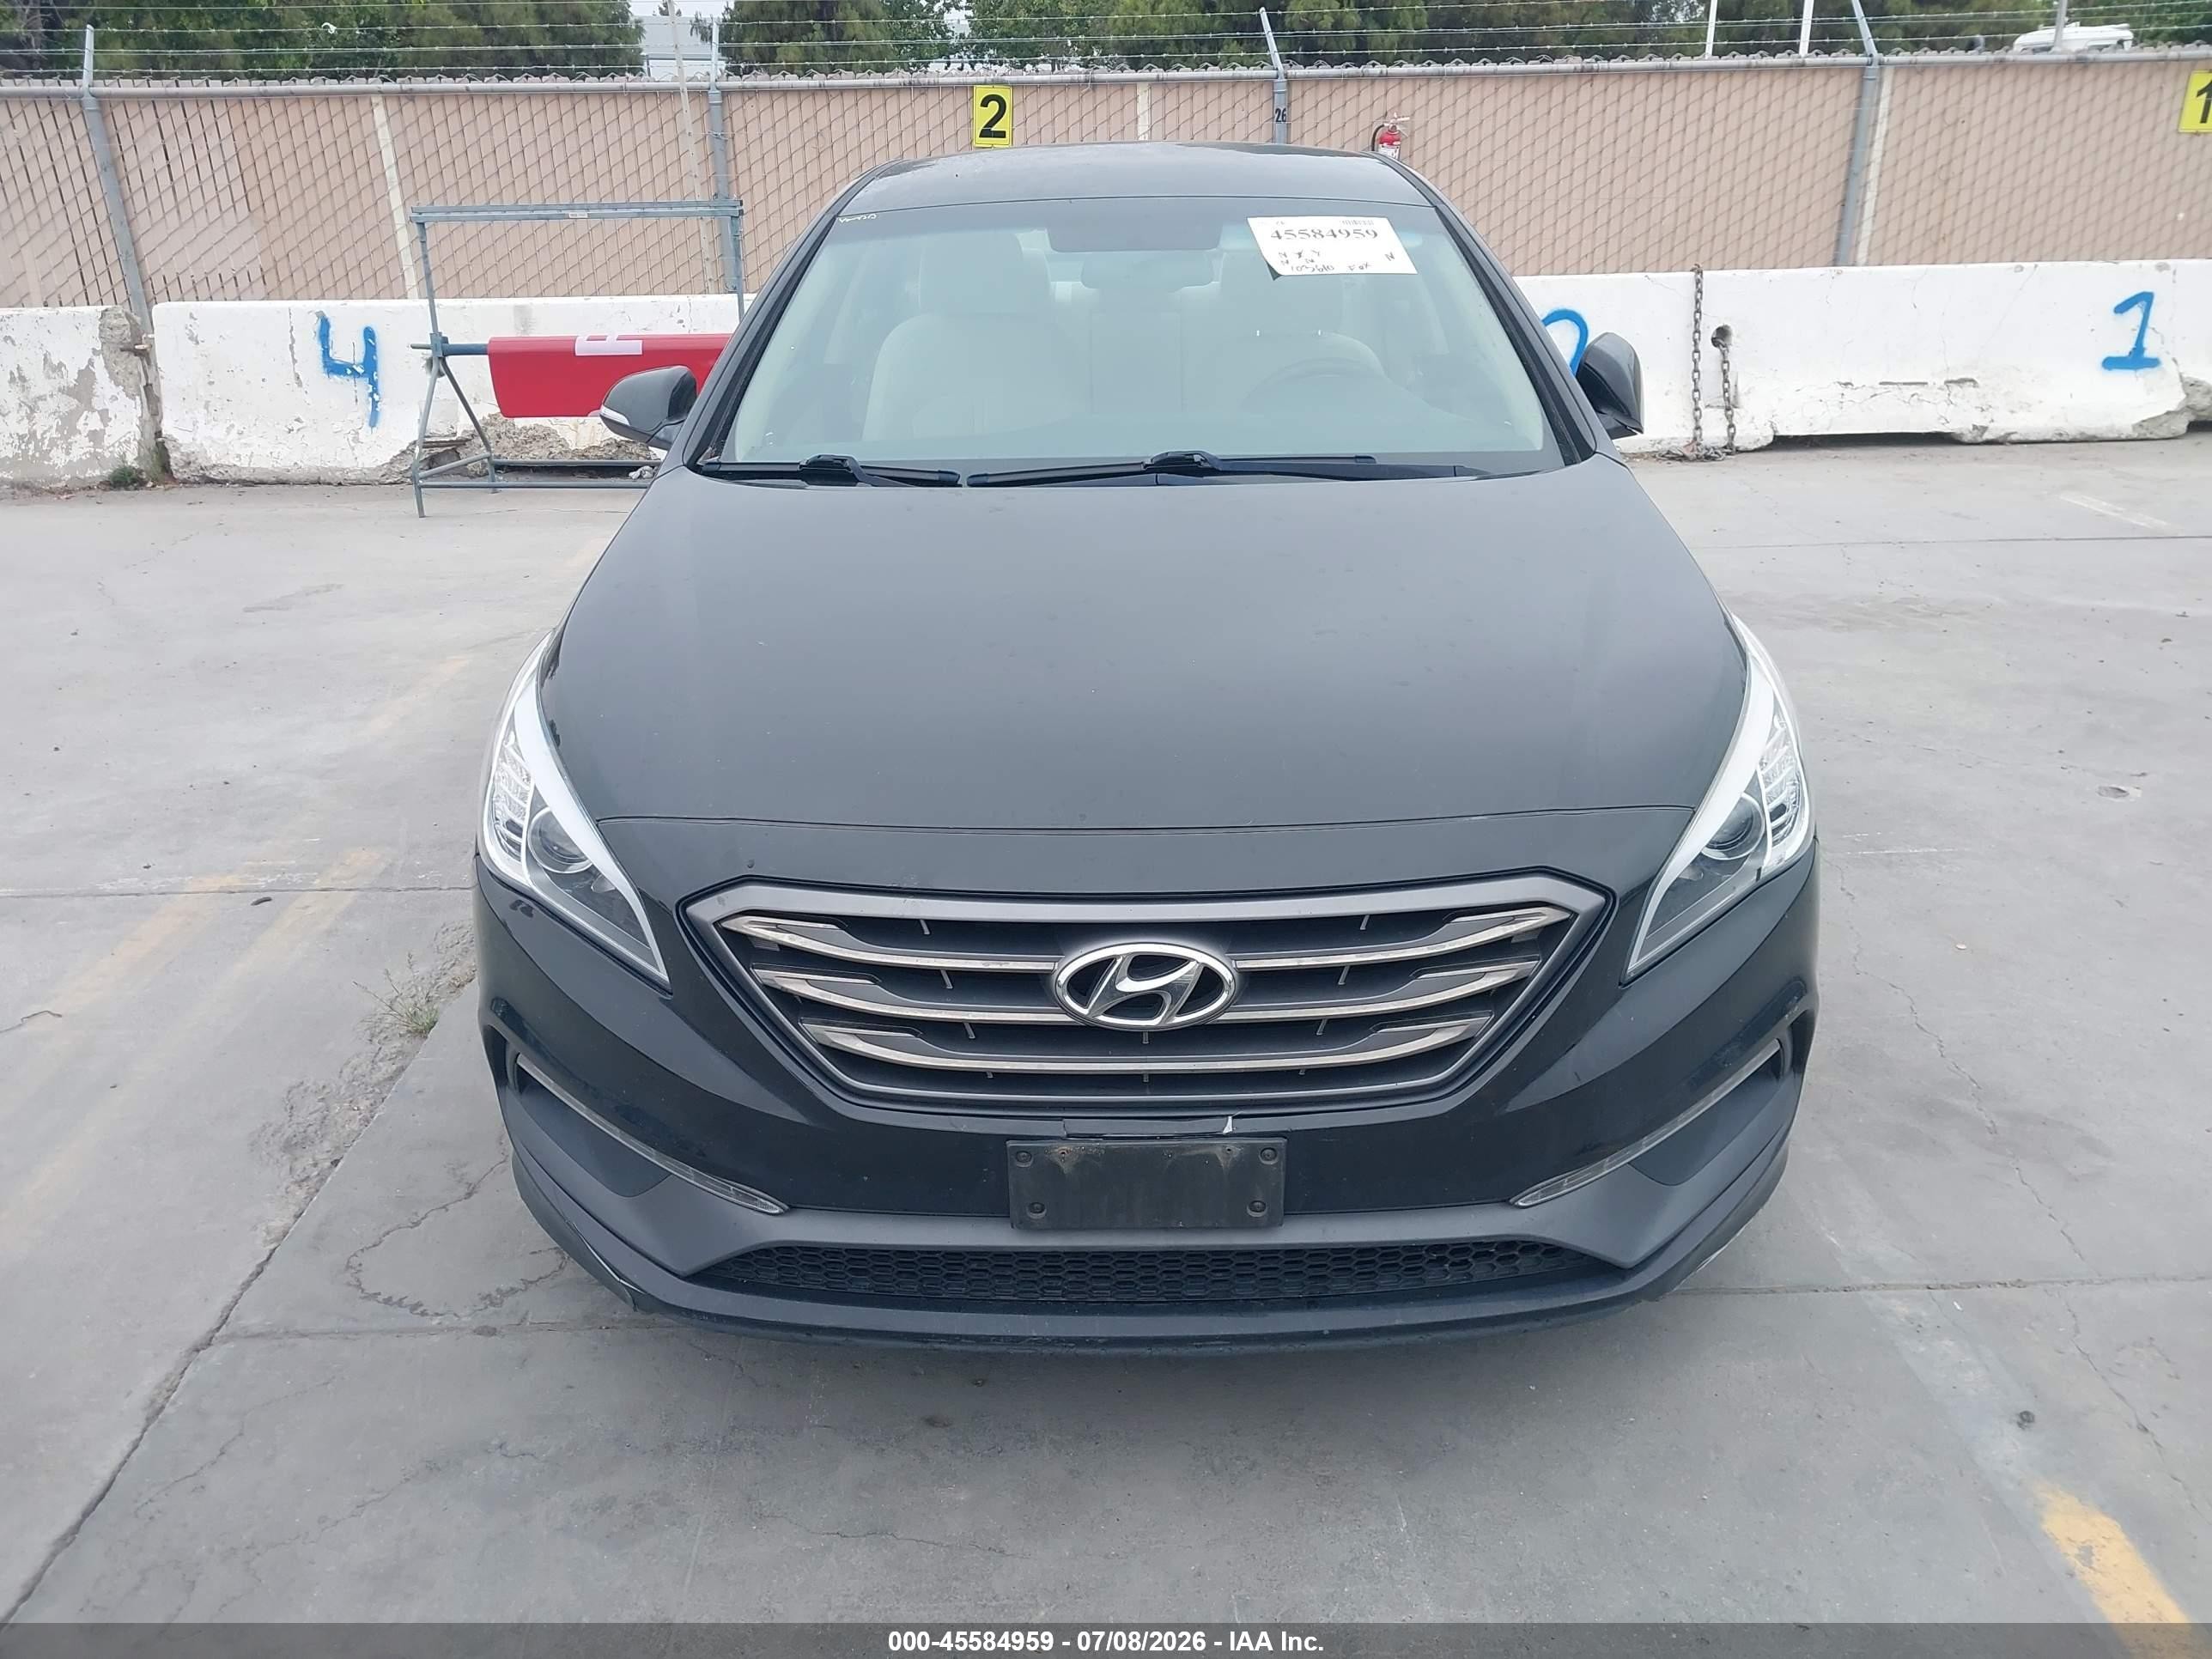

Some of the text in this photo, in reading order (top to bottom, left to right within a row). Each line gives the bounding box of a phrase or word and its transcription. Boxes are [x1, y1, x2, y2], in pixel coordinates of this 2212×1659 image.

[978, 94, 1007, 138] 2
[1274, 107, 1287, 123] 26
[1270, 228, 1379, 240] 45584959
[2101, 290, 2161, 370] 1
[317, 311, 380, 430] 4
